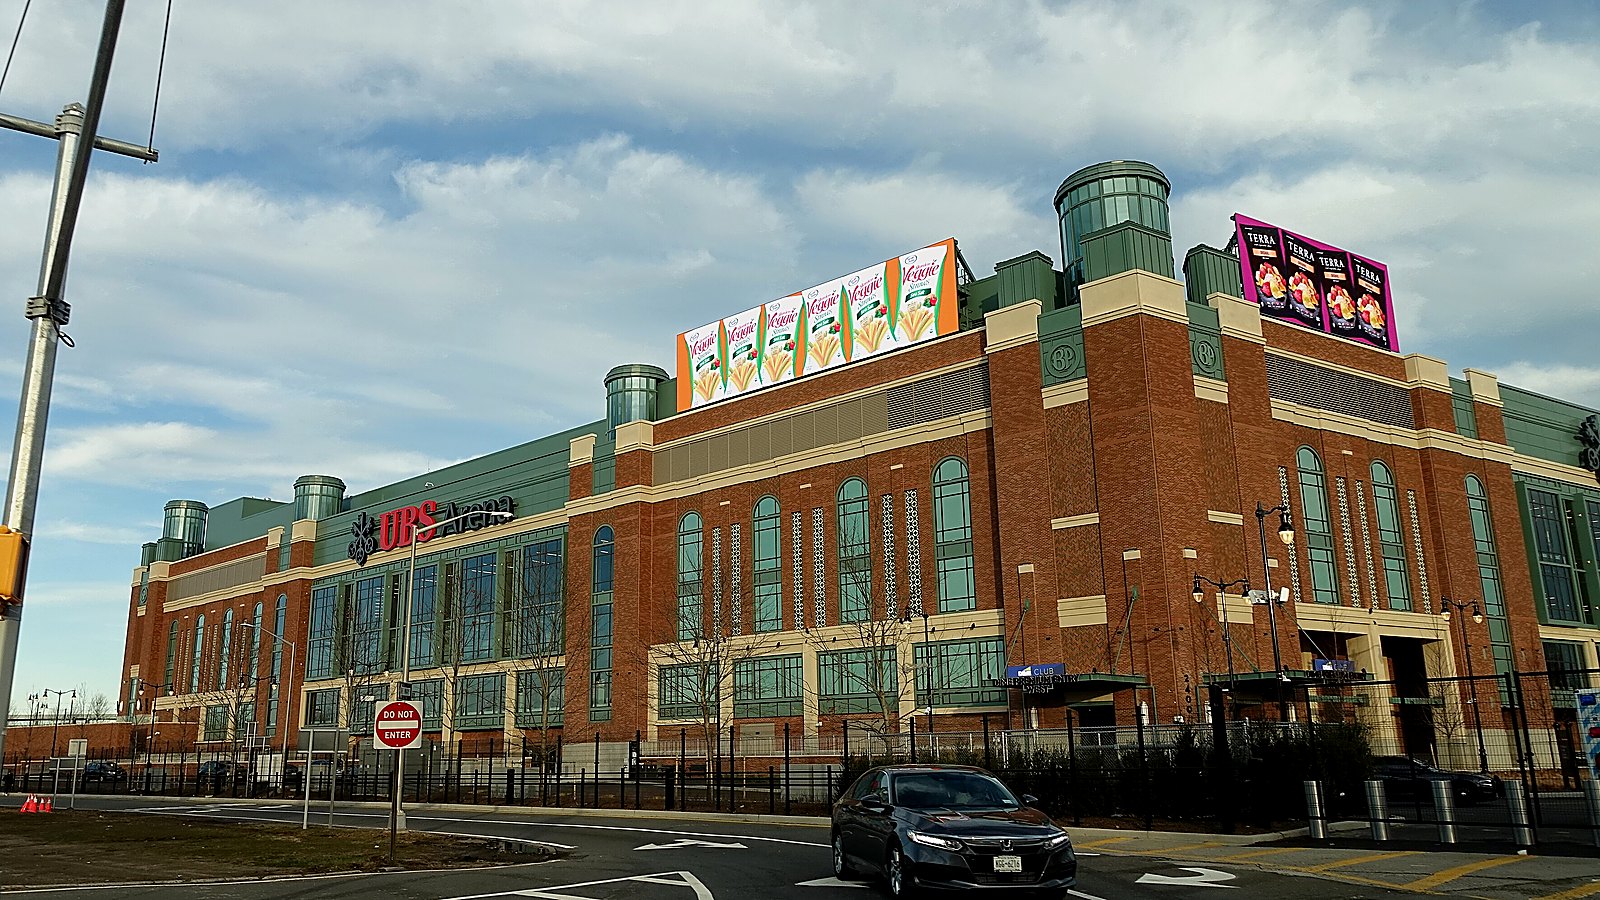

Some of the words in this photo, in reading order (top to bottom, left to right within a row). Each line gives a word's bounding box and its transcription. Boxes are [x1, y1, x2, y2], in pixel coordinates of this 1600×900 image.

[1247, 232, 1276, 245] TERRA
[1288, 241, 1315, 262] TERRA
[1319, 256, 1345, 268] TERRA
[902, 262, 940, 286] Veggie
[1355, 264, 1381, 284] TERRA
[848, 276, 883, 307] Veggie
[806, 292, 839, 319] Veggie
[767, 310, 798, 331] Veggie
[728, 321, 757, 346] Veggie
[690, 333, 717, 360] Veggie
[378, 499, 437, 551] UBS
[441, 496, 516, 538] Arena
[1034, 667, 1055, 676] CLUB
[383, 711, 395, 719] DO
[398, 710, 414, 718] NOT
[384, 731, 411, 739] ENTER
